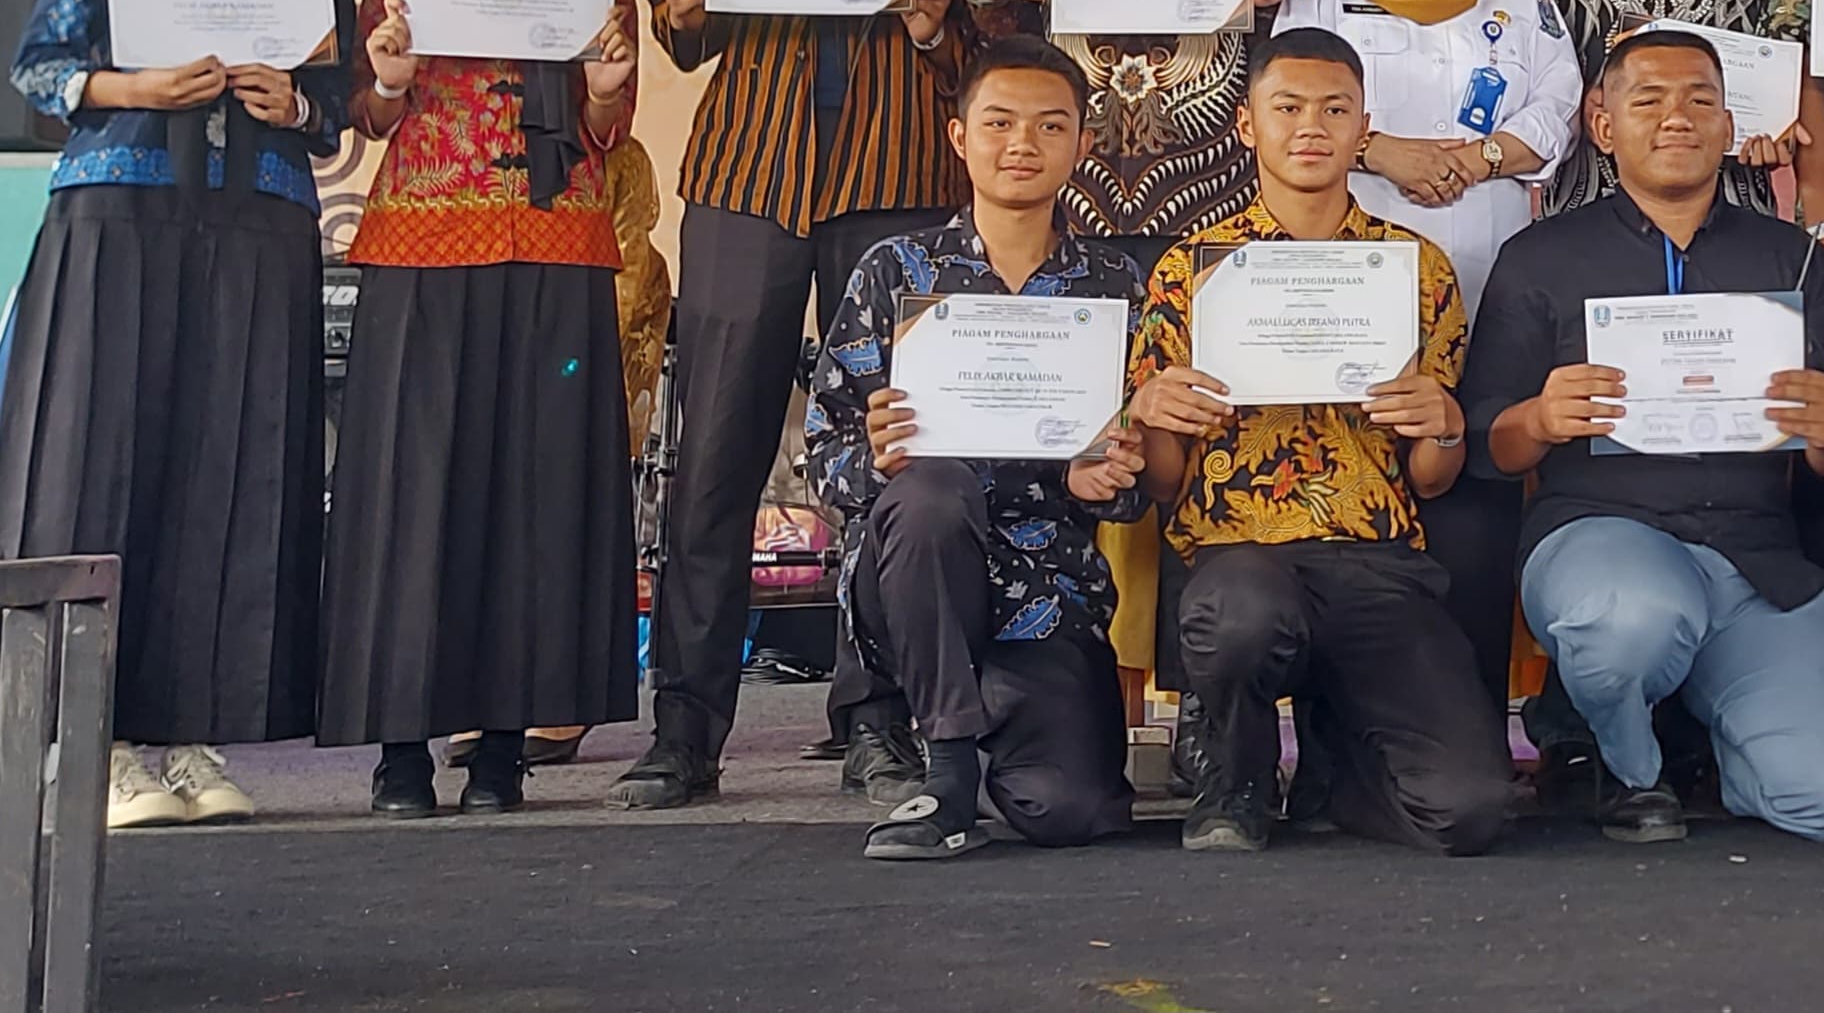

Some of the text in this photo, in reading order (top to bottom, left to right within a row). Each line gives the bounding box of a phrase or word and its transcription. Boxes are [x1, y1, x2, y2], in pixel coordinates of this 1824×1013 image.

[1249, 276, 1366, 287] PIAGAM PENGHARGAAN
[951, 329, 1072, 342] PIAGAM PENGHARGAAN
[1661, 328, 1735, 343] SERTIFIKAT
